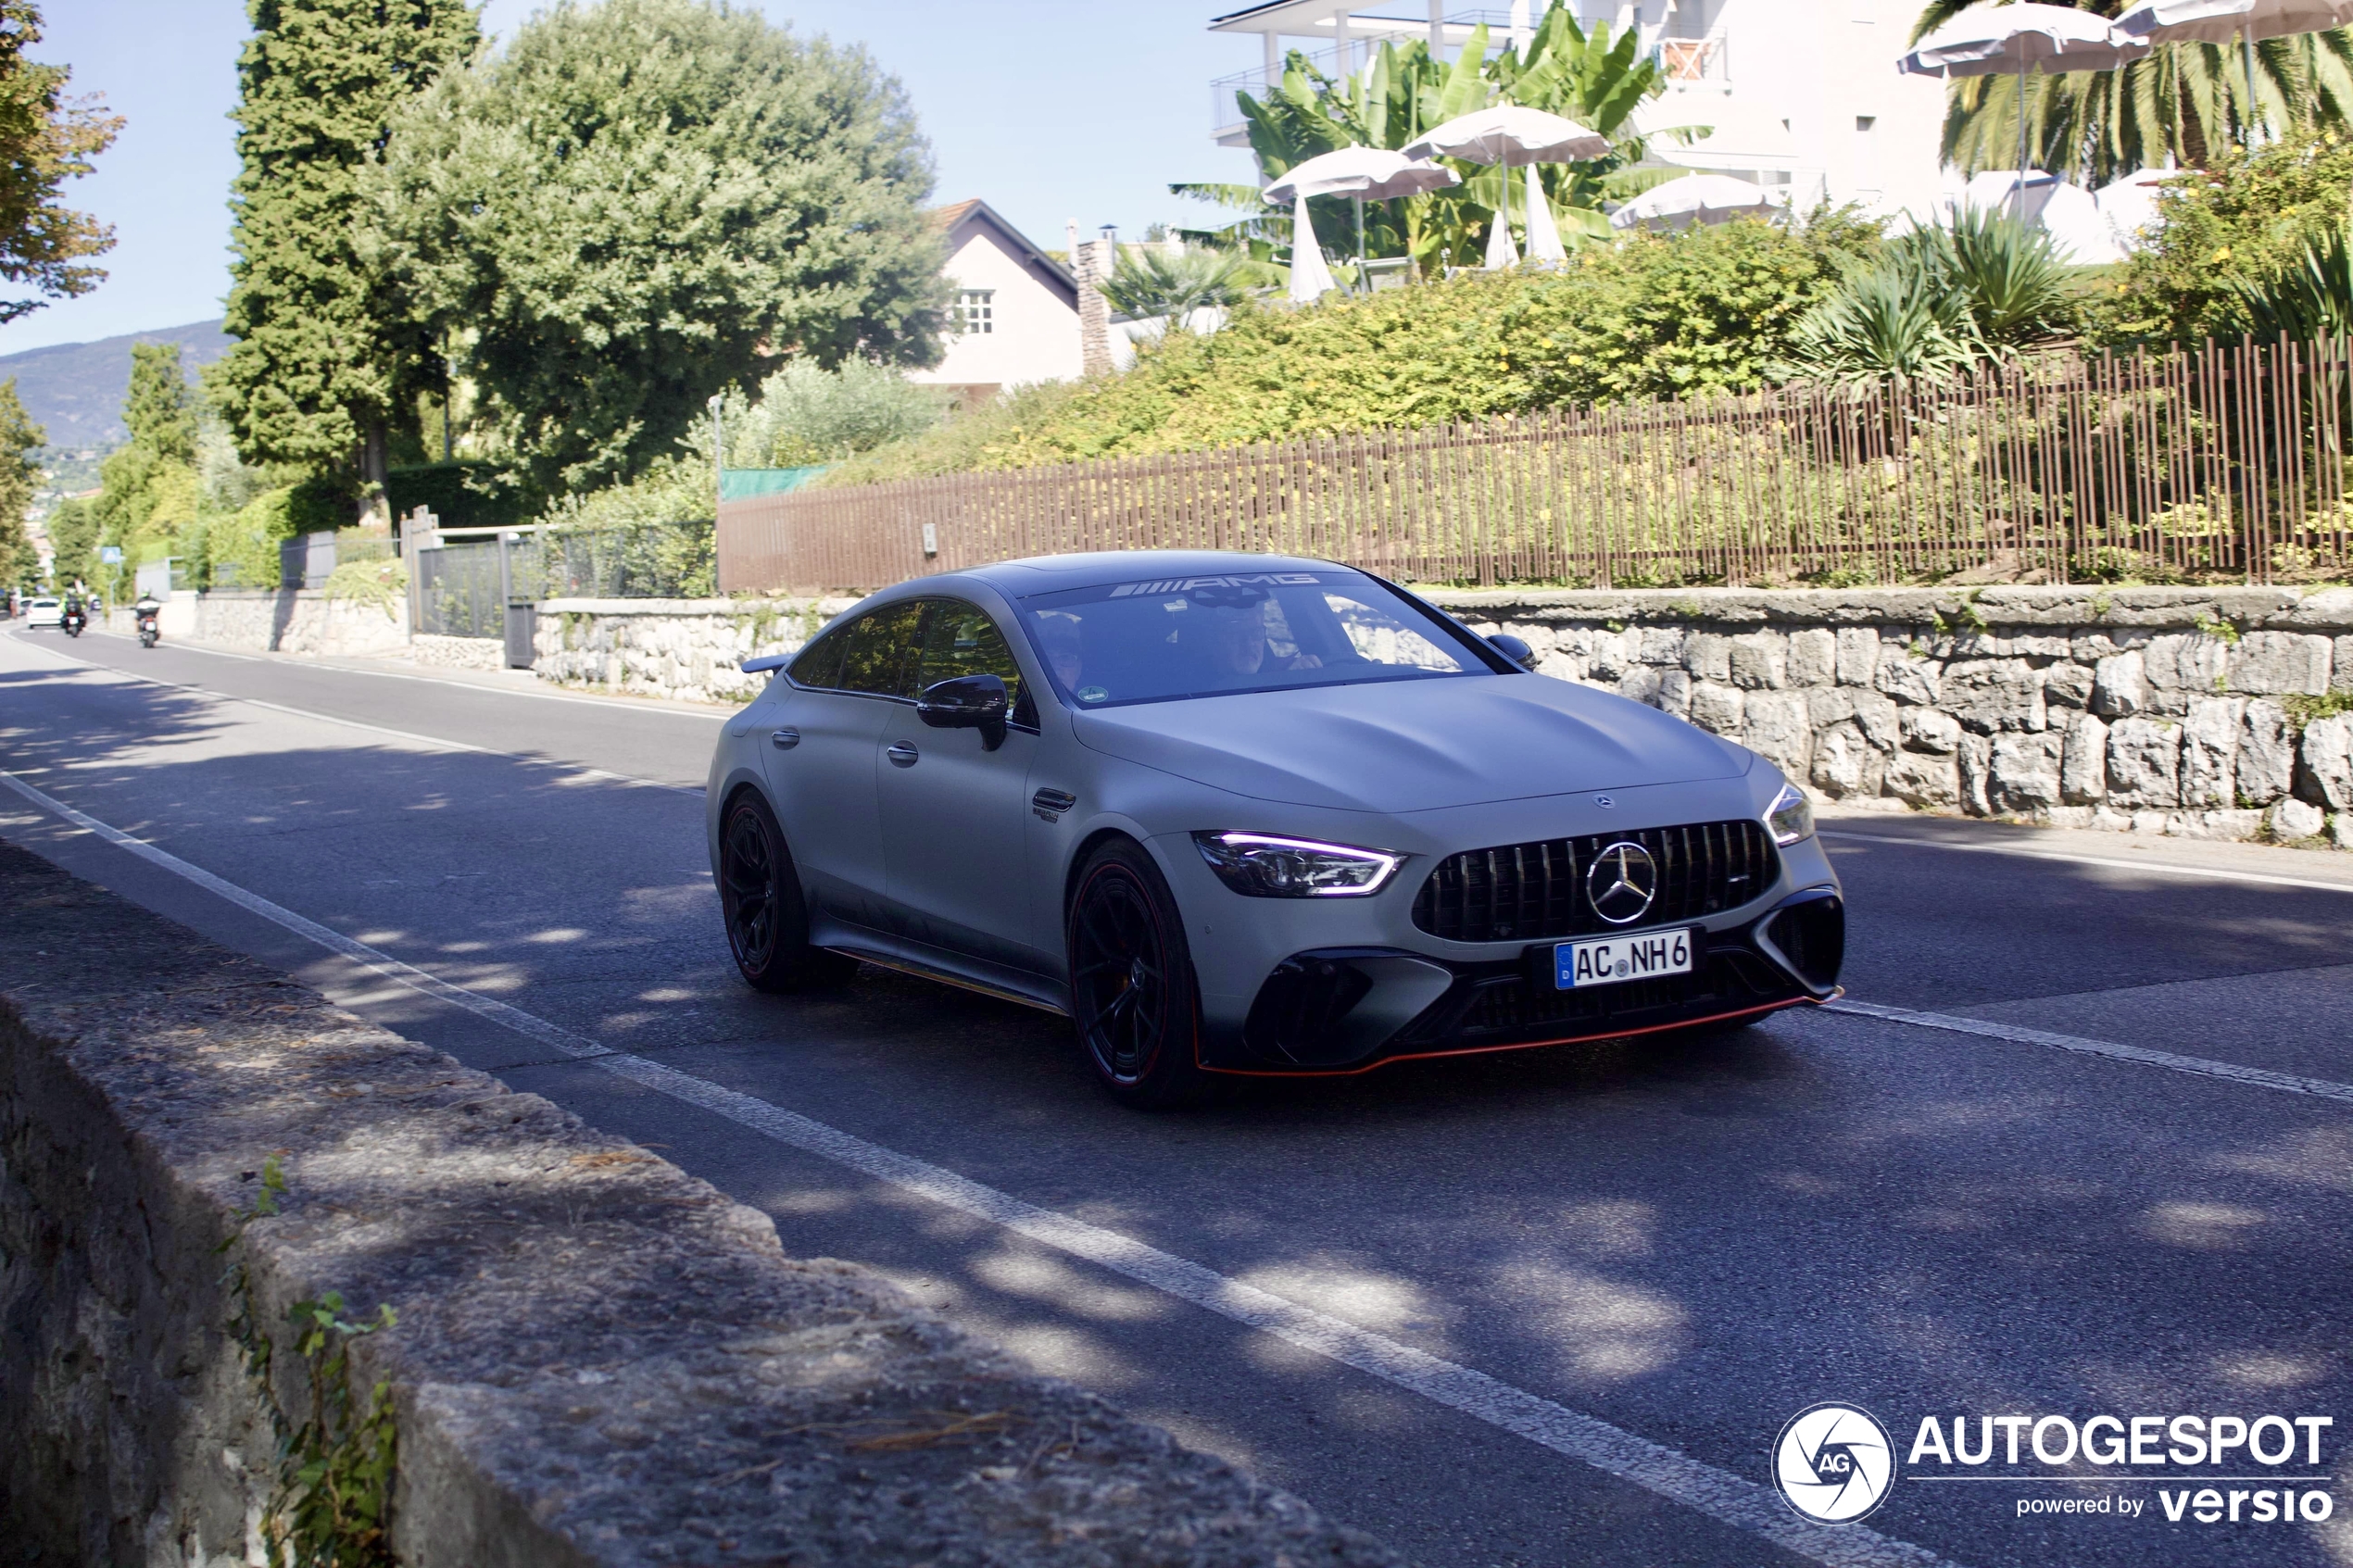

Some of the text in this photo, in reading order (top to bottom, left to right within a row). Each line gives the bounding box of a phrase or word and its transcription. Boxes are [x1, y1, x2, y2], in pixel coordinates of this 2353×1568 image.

[1181, 573, 1320, 591] AMG
[1576, 945, 1613, 981] AC
[1561, 970, 1571, 981] D
